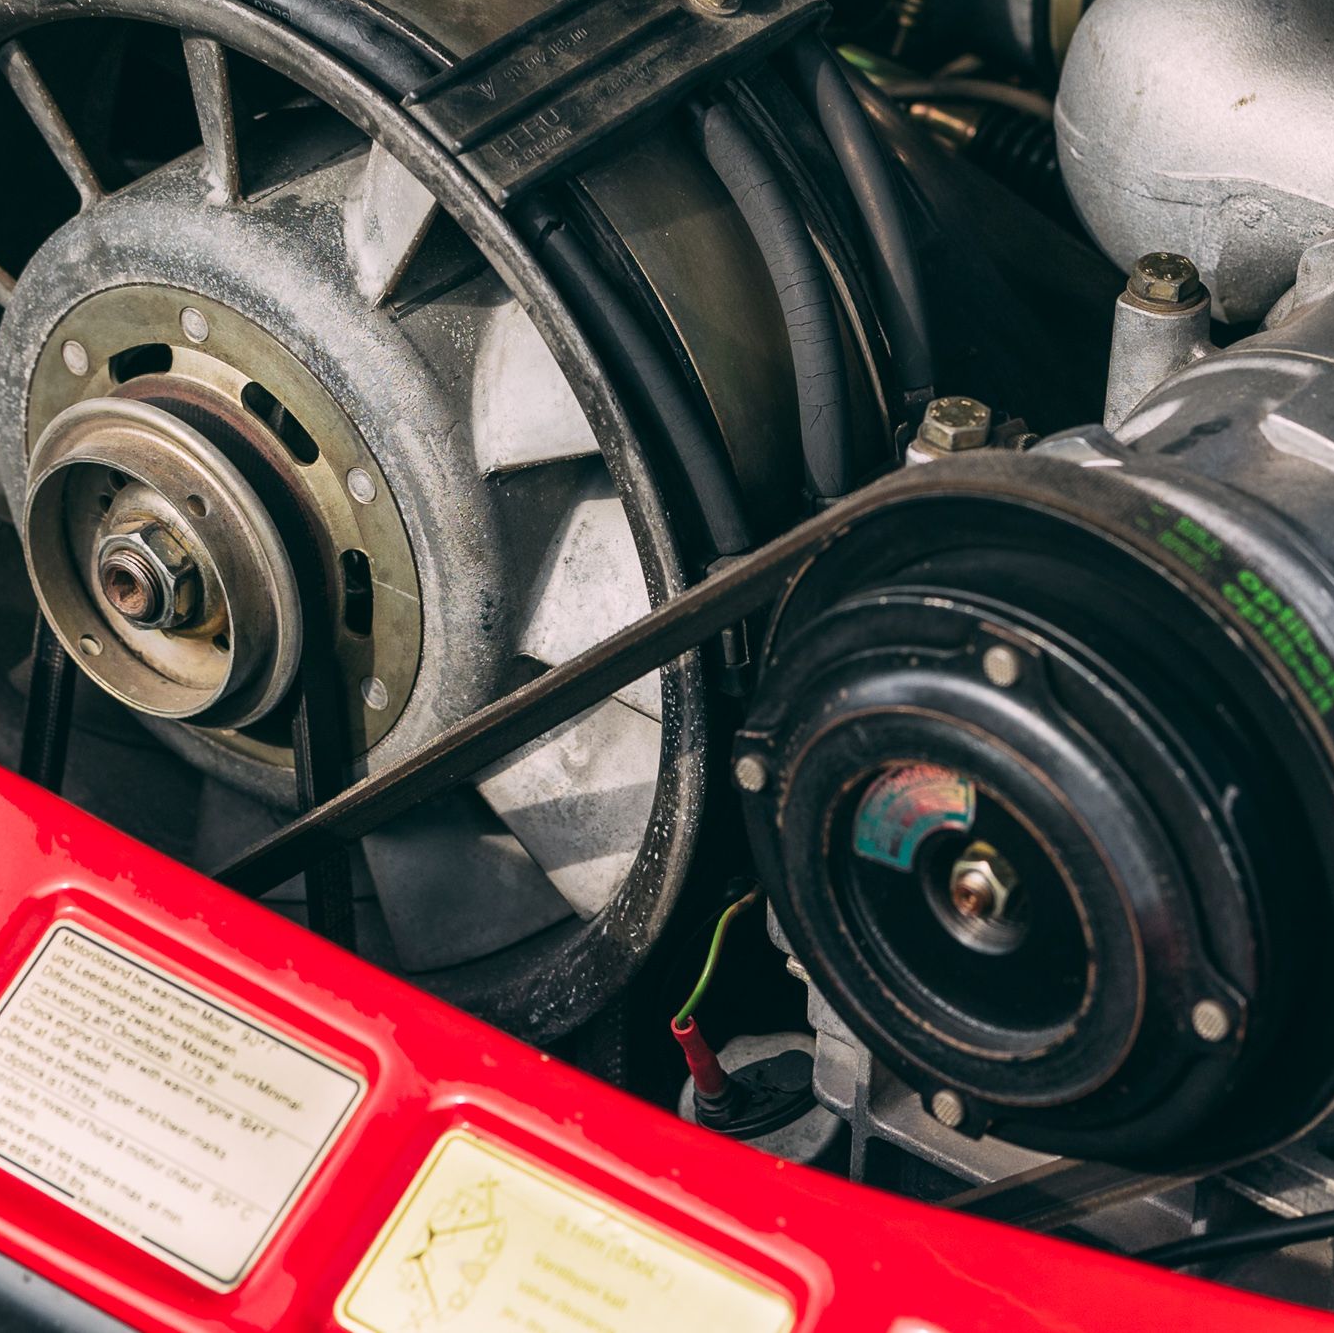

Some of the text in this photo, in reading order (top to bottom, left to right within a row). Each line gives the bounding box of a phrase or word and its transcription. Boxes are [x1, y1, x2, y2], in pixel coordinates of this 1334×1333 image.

[51, 952, 73, 967] und
[28, 980, 92, 1022] markierung
[92, 1015, 111, 1029] am
[40, 965, 127, 1018] Differenzmenge
[127, 1012, 180, 1046] zwischen
[231, 1068, 256, 1087] und
[131, 974, 150, 988] bei
[151, 985, 199, 1014] warmem
[200, 1009, 233, 1032] Motor
[9, 1013, 32, 1030] and
[33, 1025, 48, 1039] at
[48, 1034, 71, 1051] idle
[3, 1051, 46, 1080] dipstick
[19, 997, 55, 1022] Check
[53, 1019, 92, 1046] engine
[93, 1037, 112, 1053] Oil
[111, 1048, 137, 1067] level
[139, 1063, 162, 1080] with
[162, 1077, 194, 1099] warm
[193, 1095, 234, 1123] engine
[54, 1059, 102, 1090] between
[102, 1087, 134, 1110] upper
[136, 1103, 160, 1122] and
[158, 1115, 191, 1139] lower
[7, 1142, 26, 1157] est
[25, 1151, 43, 1166] de
[26, 1131, 55, 1152] entre
[55, 1148, 74, 1162] les
[27, 1088, 39, 1100] le
[40, 1096, 76, 1121] niveau
[123, 1143, 165, 1172] moteur
